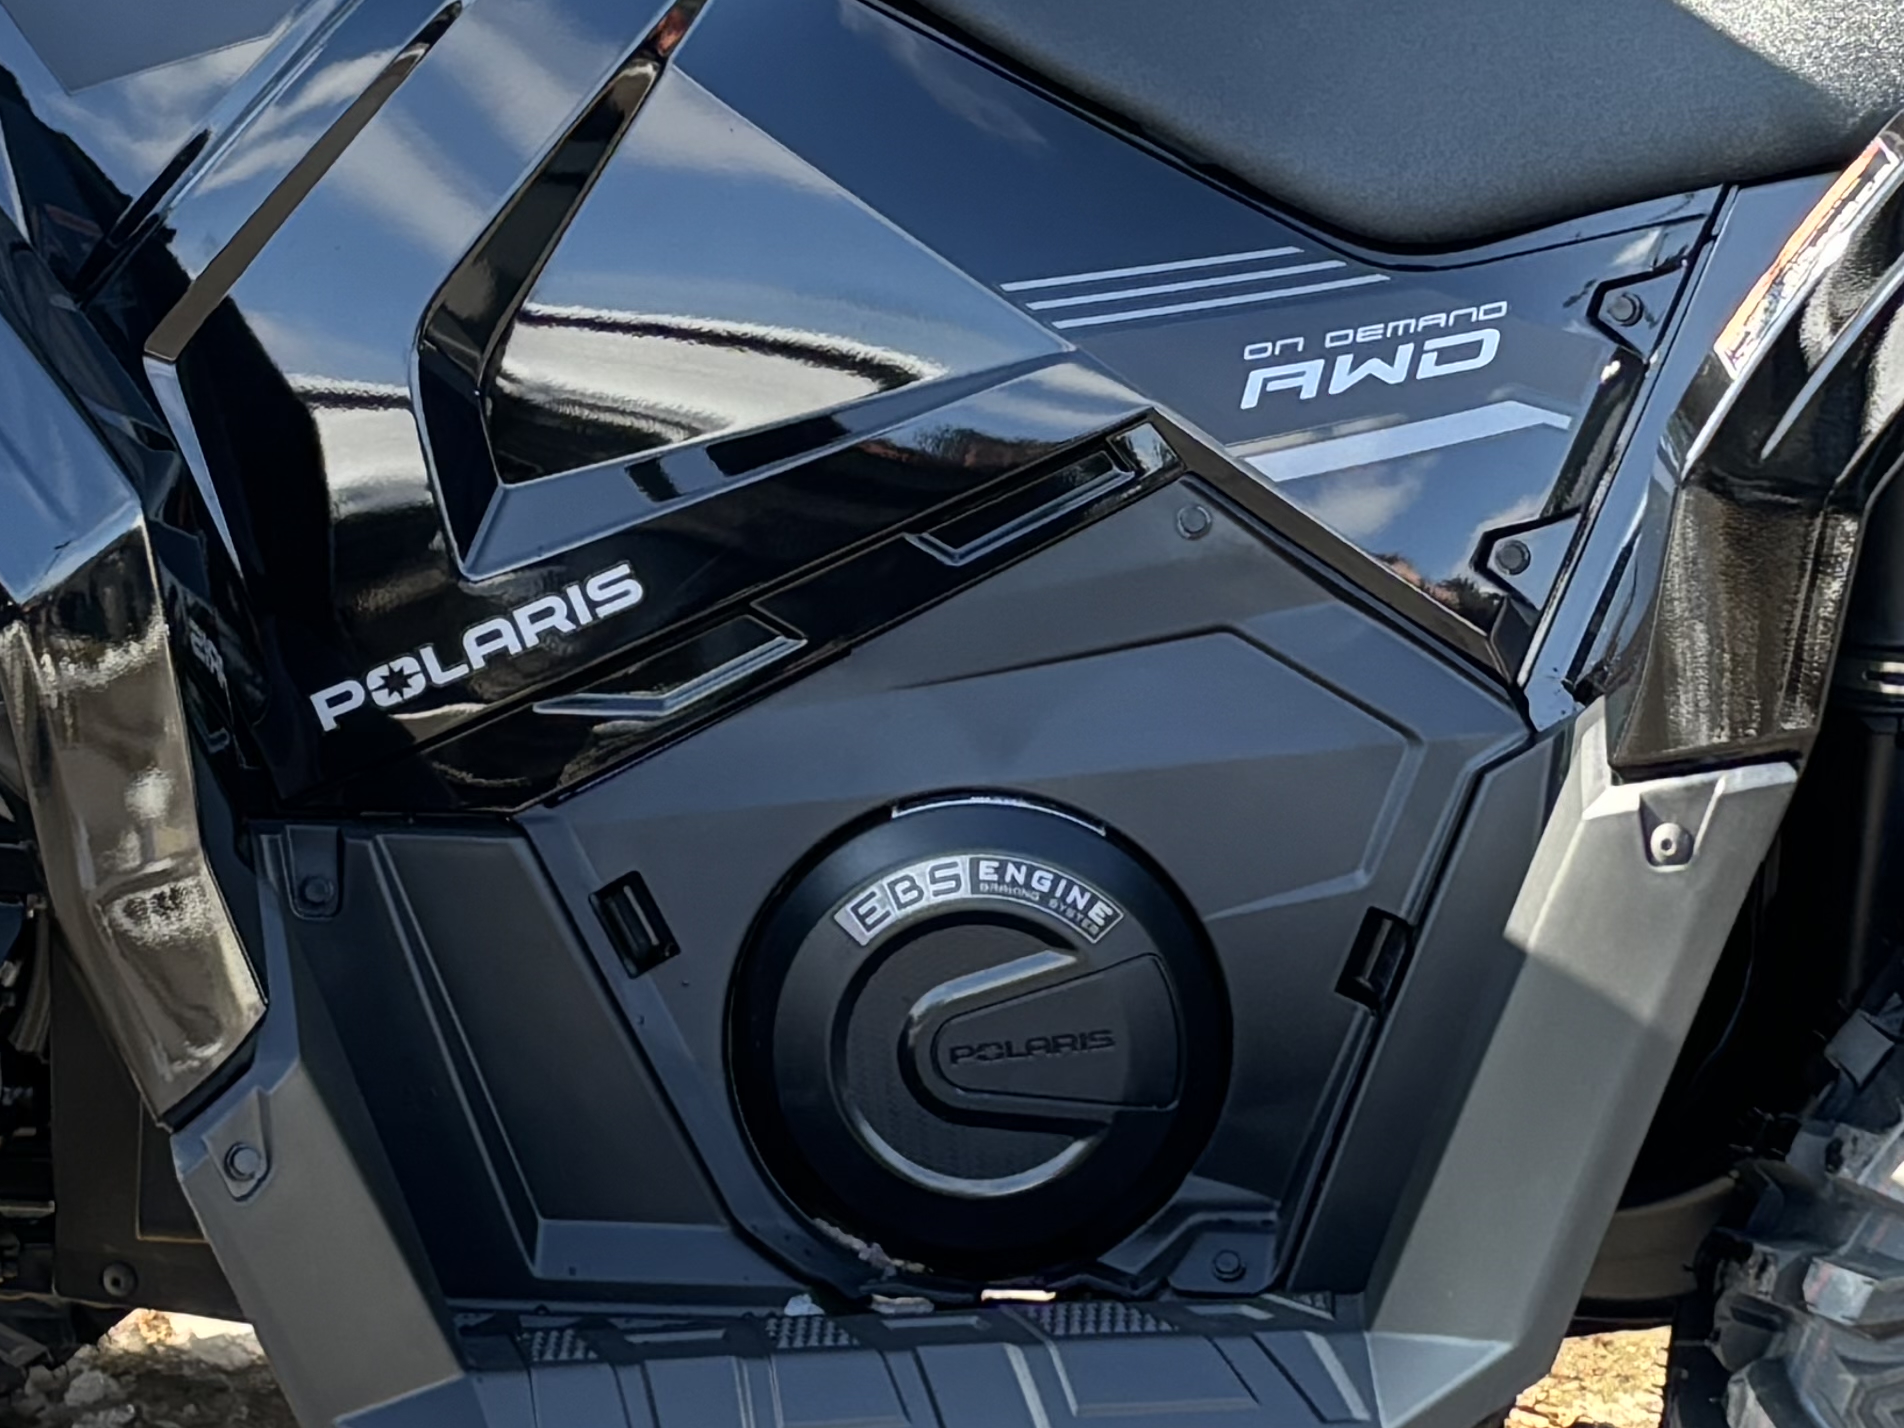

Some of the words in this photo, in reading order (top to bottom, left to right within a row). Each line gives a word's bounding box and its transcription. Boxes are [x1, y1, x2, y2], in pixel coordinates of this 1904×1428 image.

[1243, 336, 1304, 361] ON
[1325, 302, 1508, 348] DEMAND
[1241, 329, 1500, 410] AWD
[310, 563, 644, 732] POLARIS
[851, 861, 964, 933] EBS
[978, 859, 1114, 927] ENGINE
[950, 1030, 1115, 1063] POLARIS
